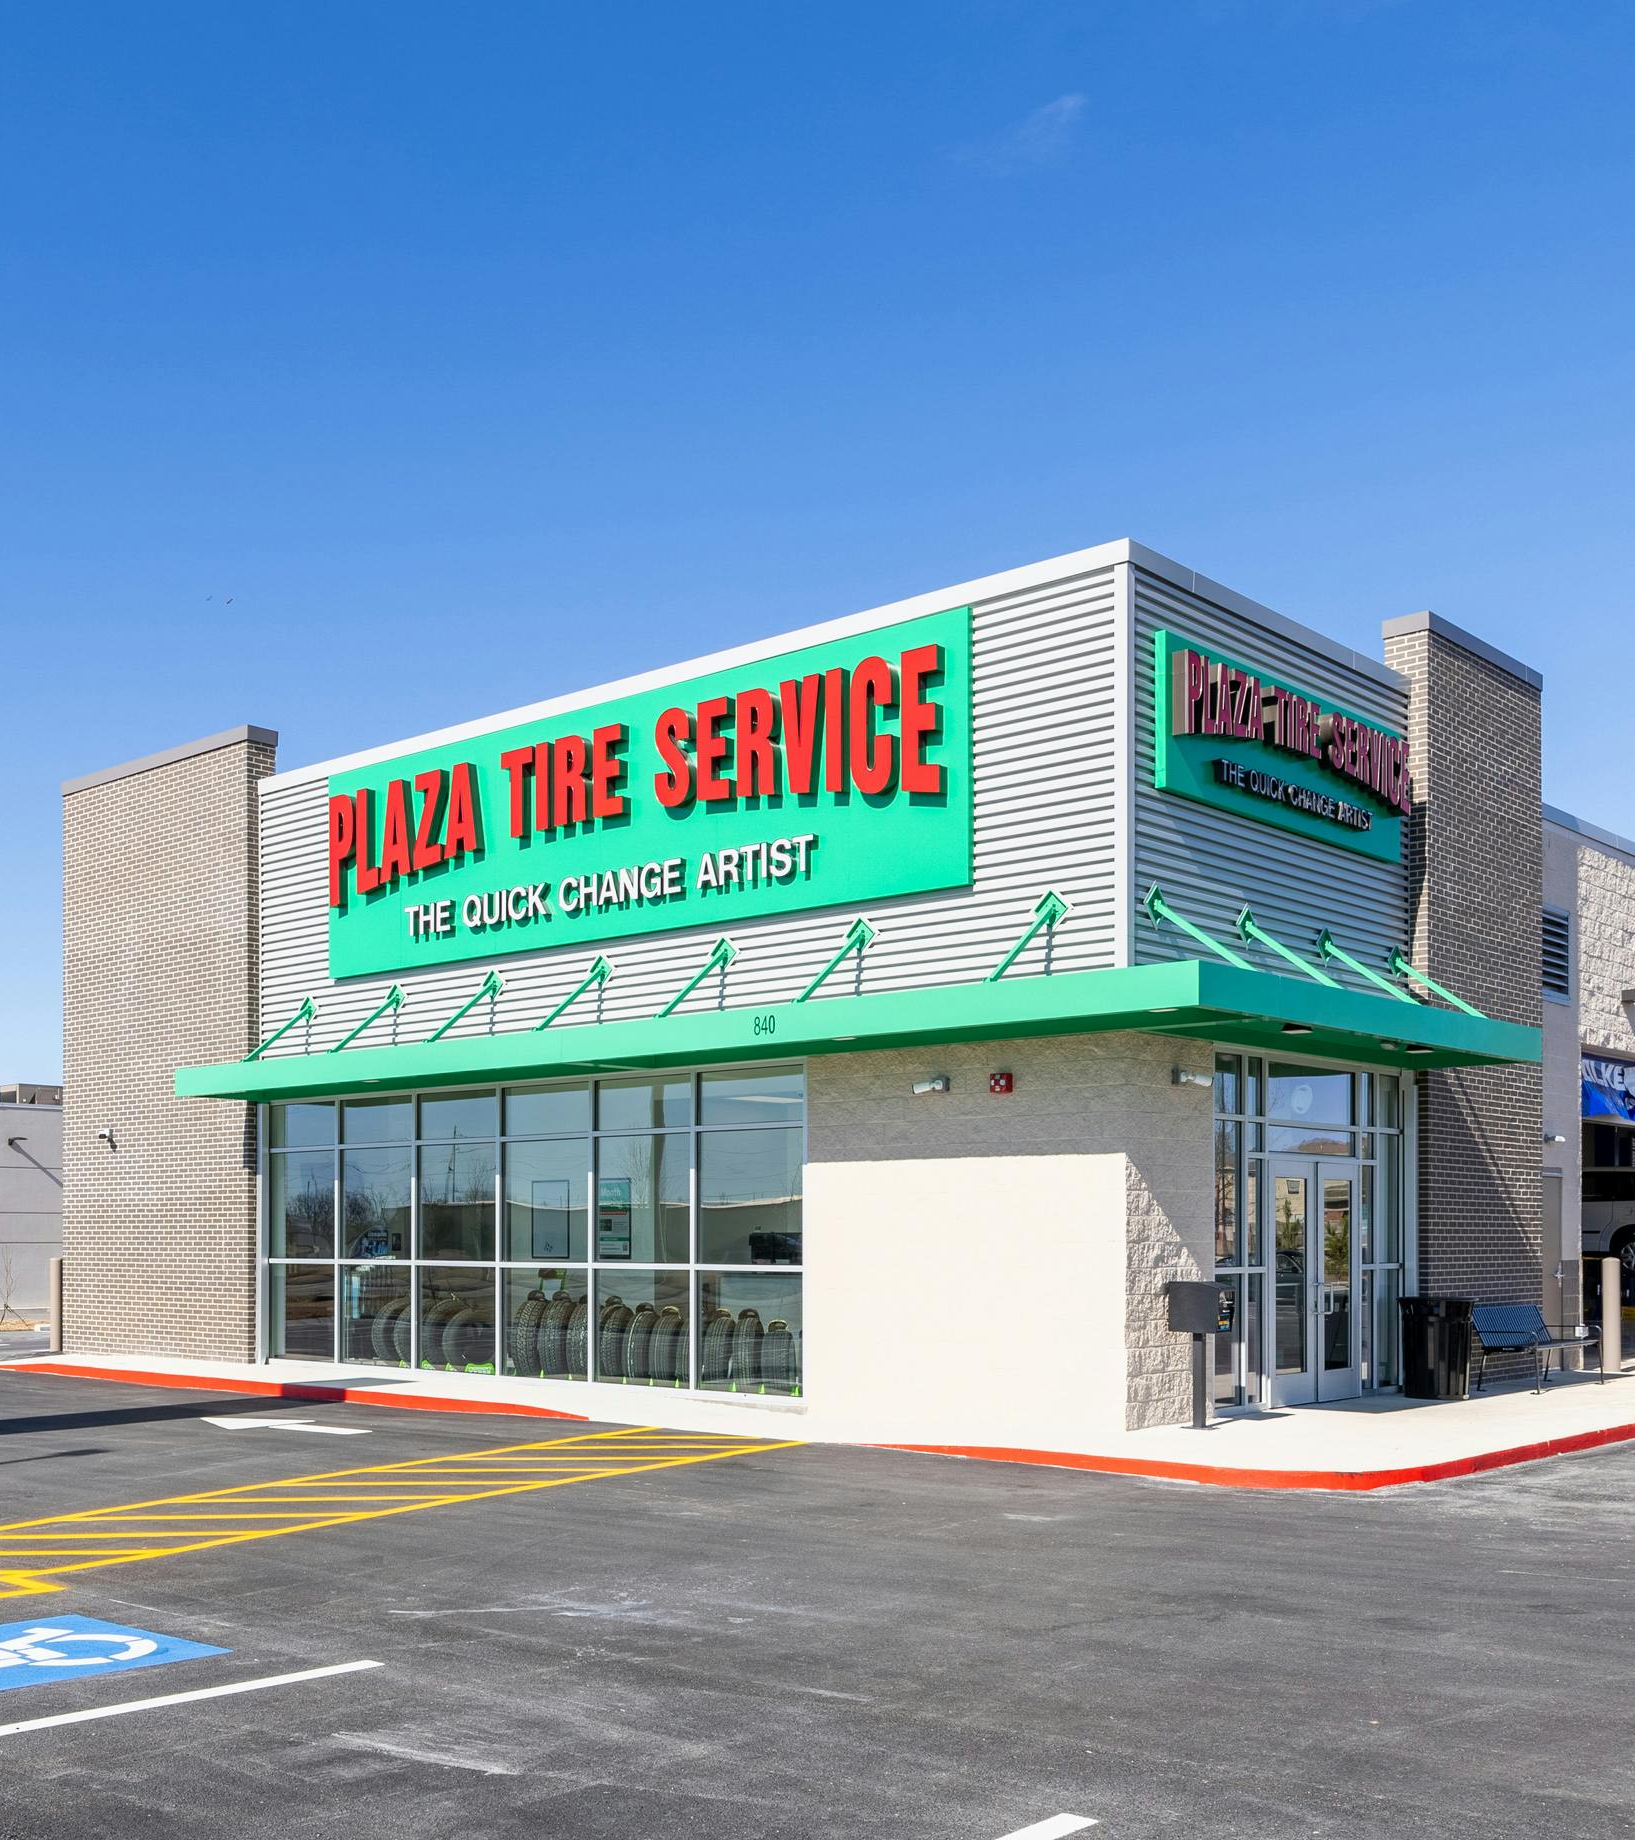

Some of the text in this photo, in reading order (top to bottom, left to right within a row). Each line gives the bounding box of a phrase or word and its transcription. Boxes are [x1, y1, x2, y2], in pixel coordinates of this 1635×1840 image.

[329, 644, 944, 907] PLAZA TIRE SERVICE
[1182, 648, 1412, 817] PLAZA TIRE SERVICE
[1220, 758, 1374, 832] THE QUICK CHANGE ARTIST
[404, 834, 815, 937] THE QUICK CHANGE ARTIST
[753, 1014, 776, 1036] 840
[1581, 1059, 1627, 1091] ALKE
